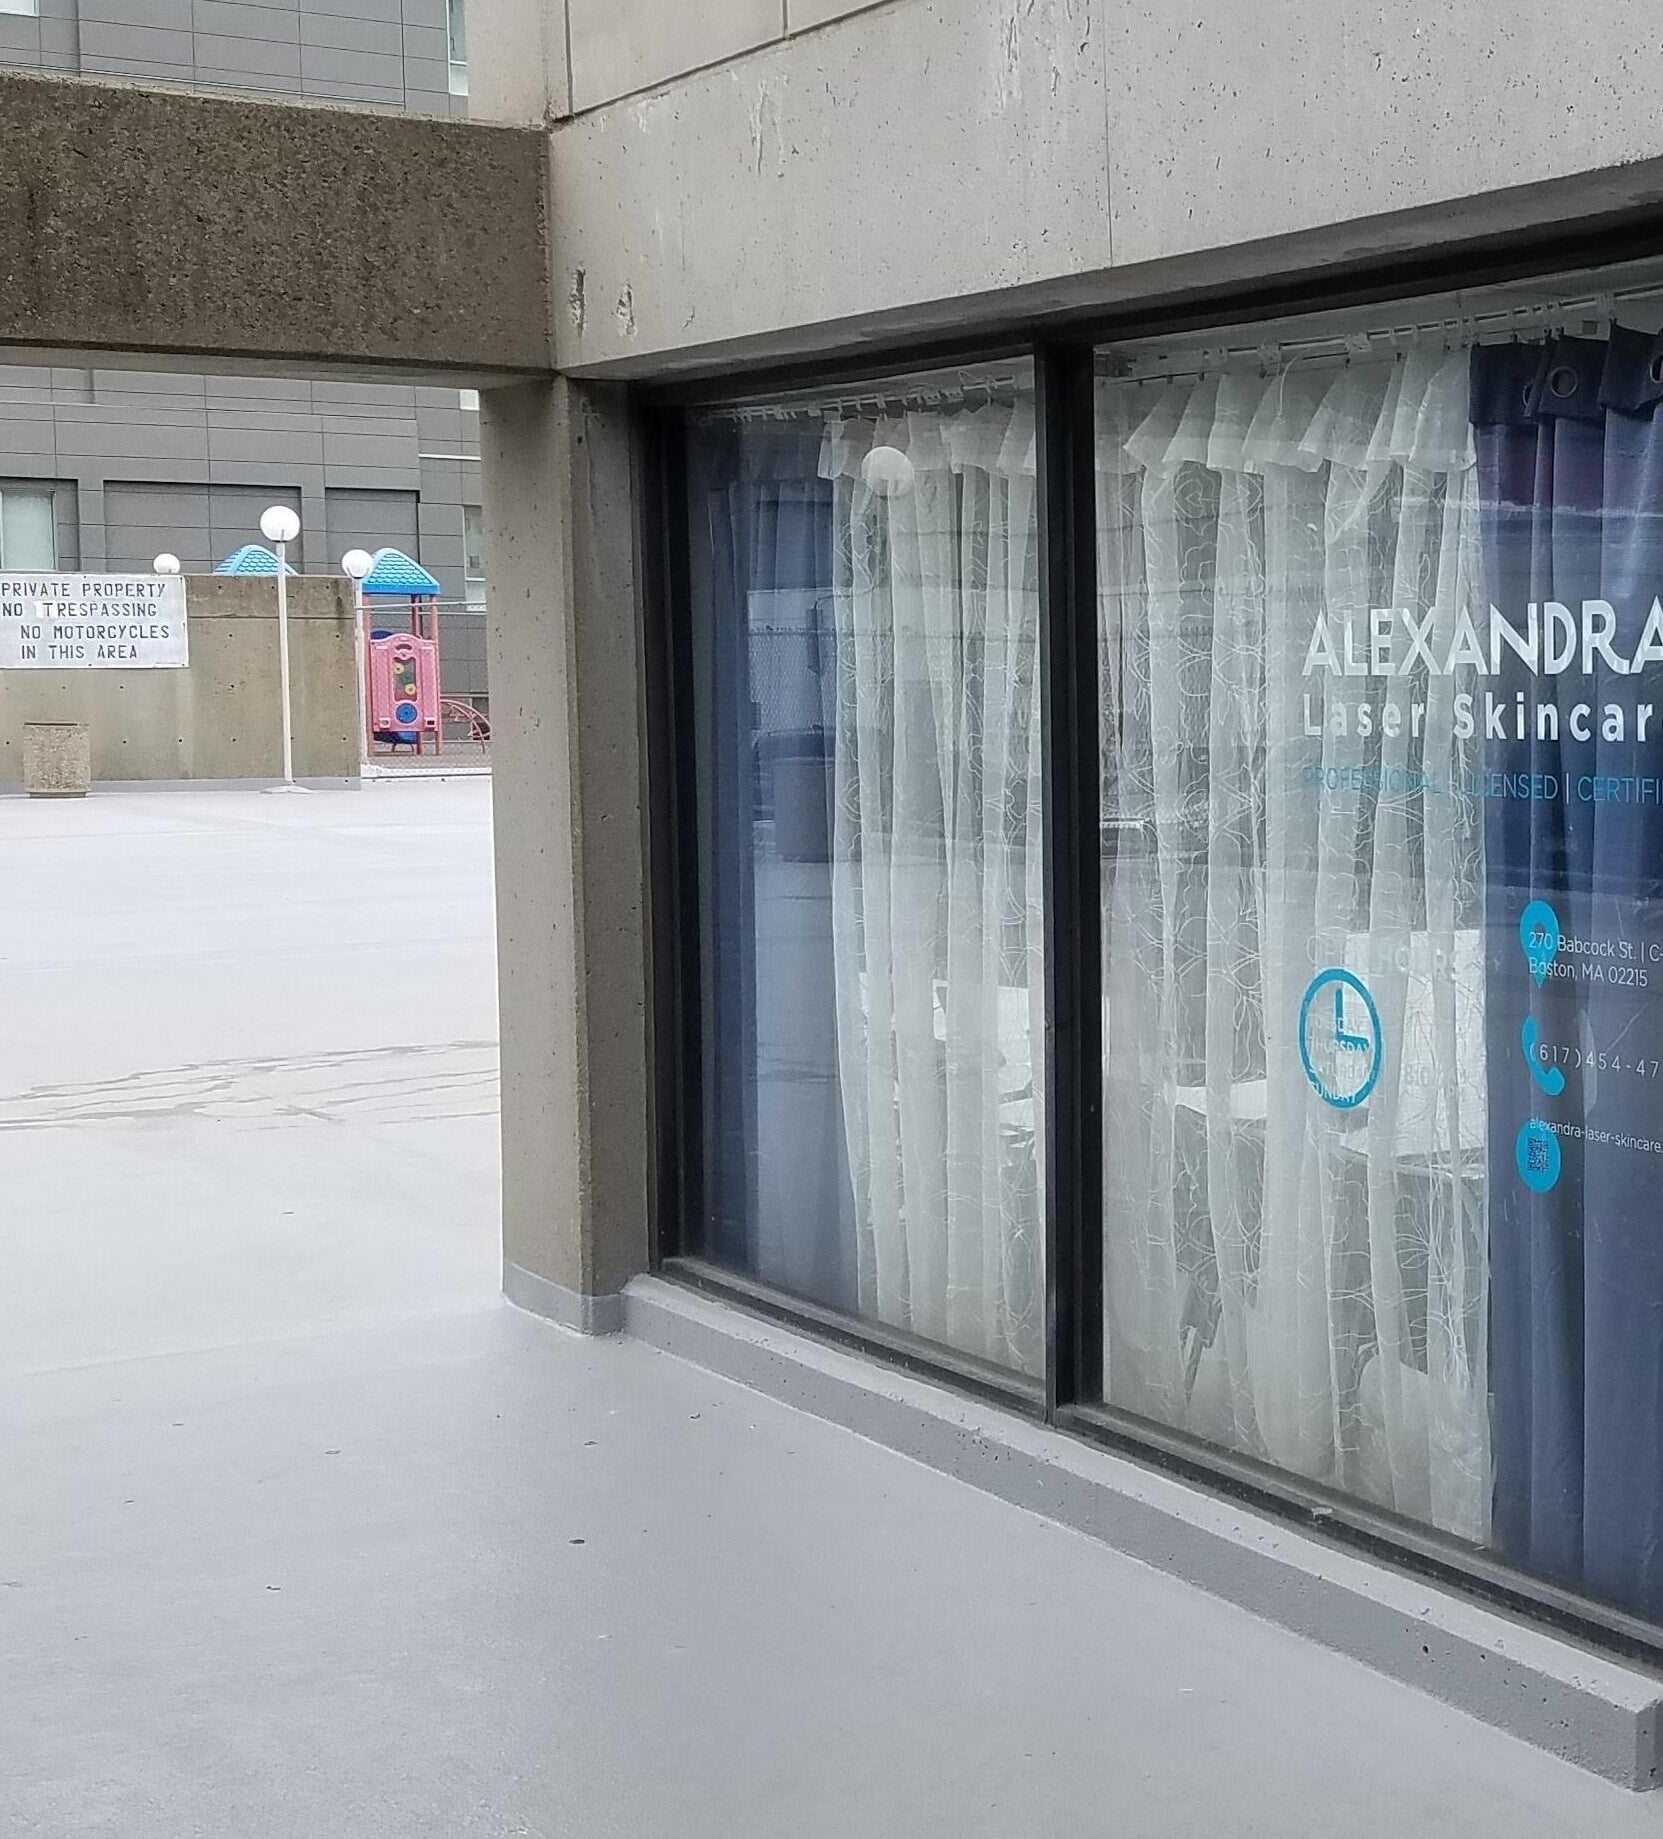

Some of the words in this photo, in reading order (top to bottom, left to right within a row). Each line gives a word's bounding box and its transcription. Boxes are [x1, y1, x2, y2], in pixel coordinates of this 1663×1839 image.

[1, 582, 71, 597] PRIVATE
[82, 582, 166, 598] PROPERTY
[2, 602, 24, 617] NO
[43, 602, 158, 617] TRESPASSING
[20, 625, 42, 639] NO
[53, 625, 170, 639] MOTORCYCLES
[21, 645, 36, 660] IN
[48, 645, 85, 660] THIS
[97, 645, 138, 660] AREA
[1303, 693, 1425, 738] Laser
[1528, 932, 1553, 950] 270
[1557, 934, 1615, 957] Babcock
[1619, 941, 1637, 960] St.
[1529, 957, 1578, 981] Boston,
[1582, 963, 1605, 982] MA
[1608, 966, 1649, 987] 02215
